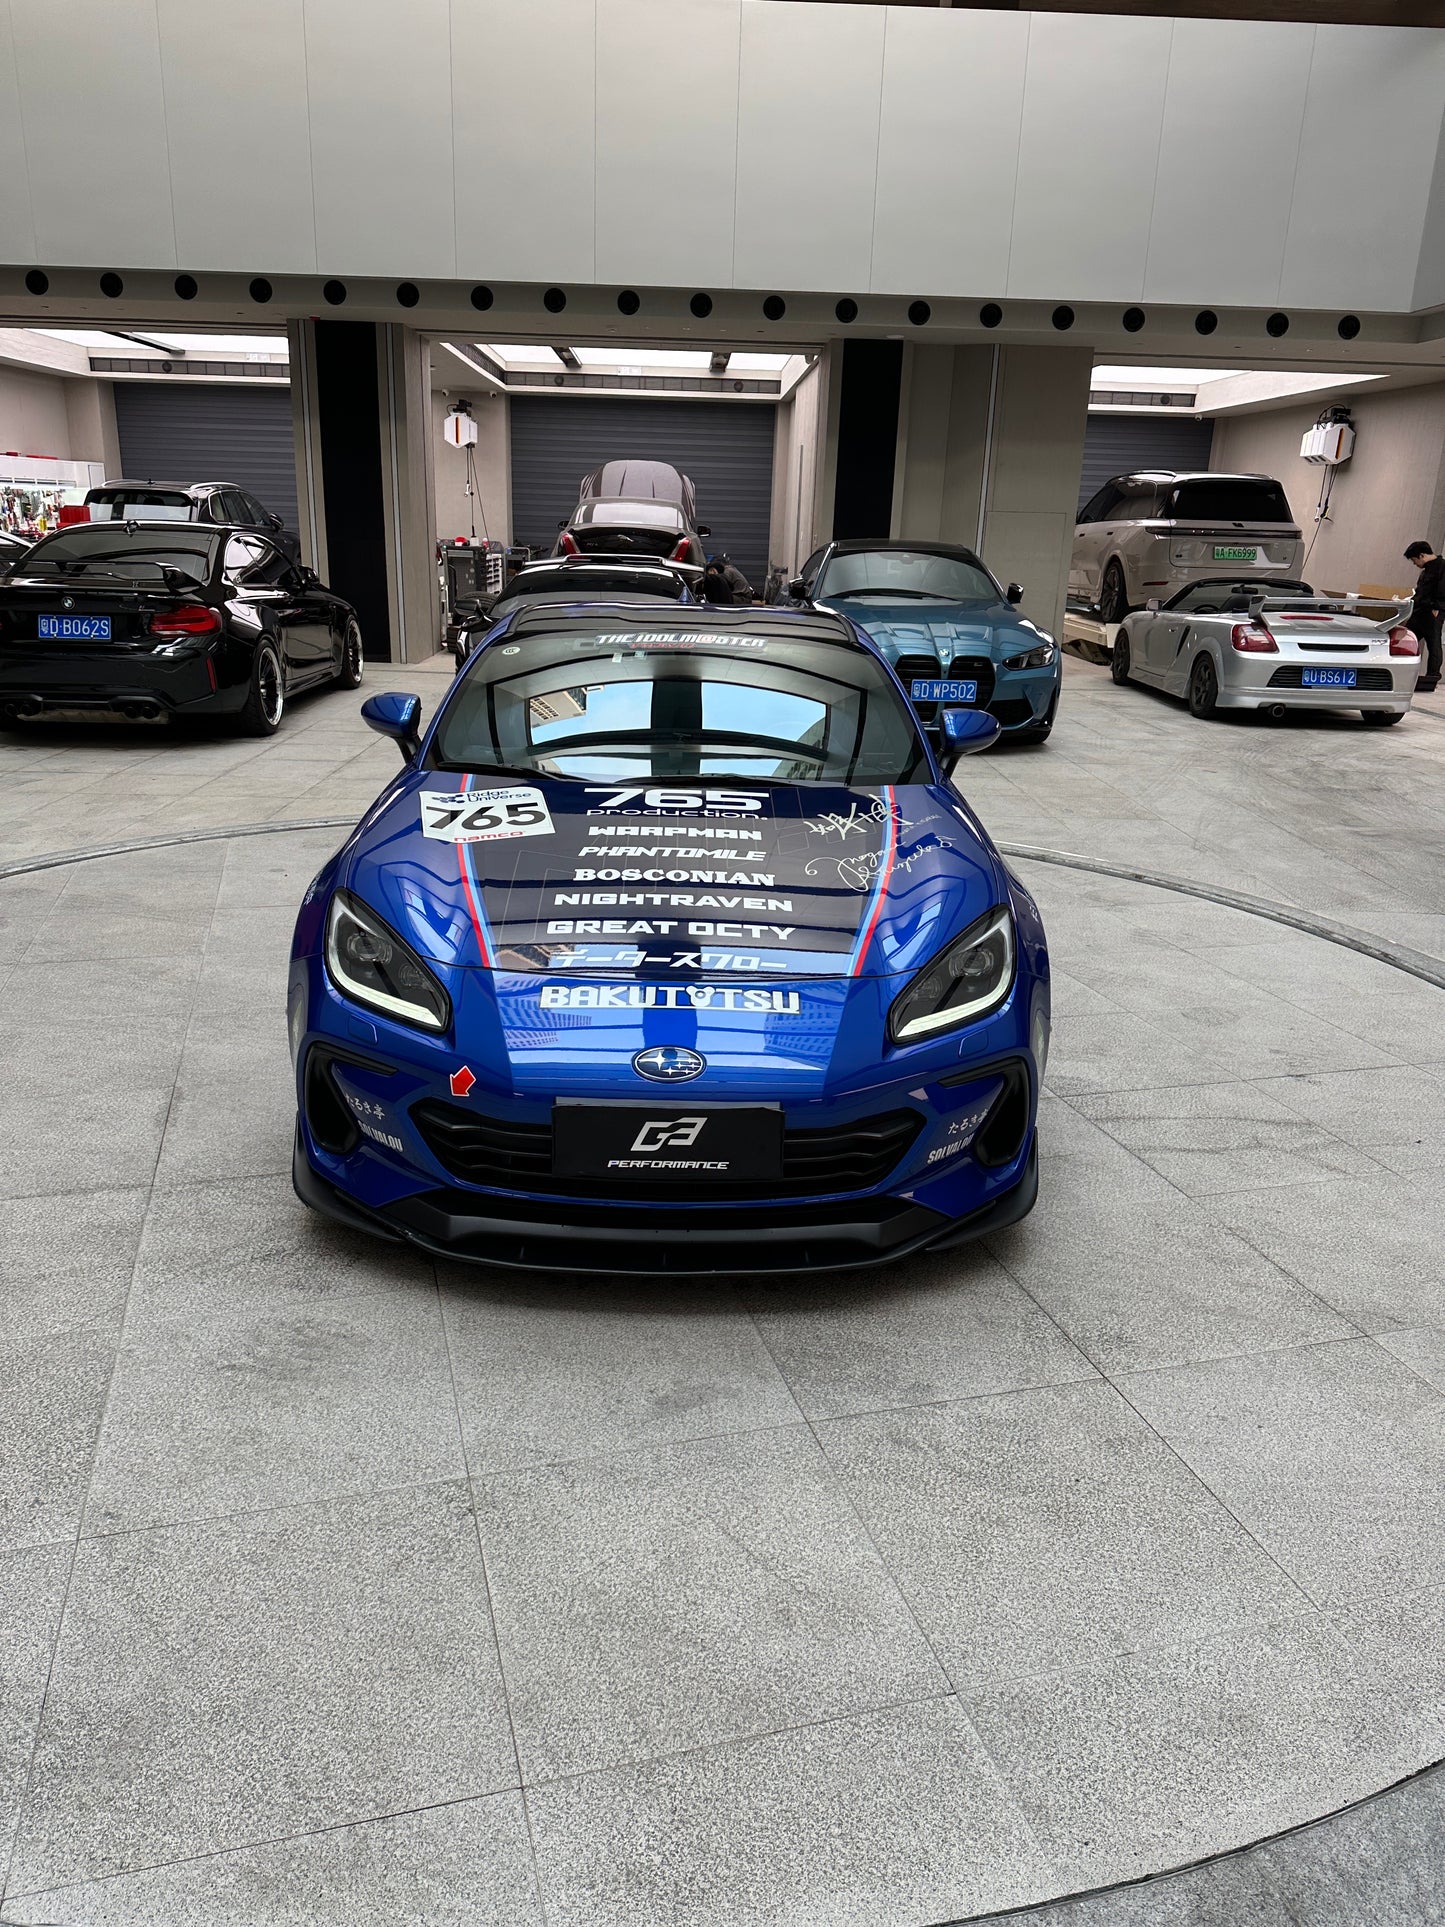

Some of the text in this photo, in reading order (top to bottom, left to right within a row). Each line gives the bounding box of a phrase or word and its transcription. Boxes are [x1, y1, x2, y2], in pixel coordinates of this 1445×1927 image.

[467, 790, 509, 798] Ridge
[468, 792, 532, 802] Universe
[584, 788, 769, 811] 765
[426, 802, 546, 830] 765
[454, 831, 524, 842] namco
[588, 826, 762, 840] WARPMAN
[578, 846, 766, 861] PHANTOMILE
[572, 869, 775, 886] BOSCONIAN
[554, 893, 793, 911] NIGHTRAVEN
[546, 920, 796, 940] GREAT OCTY
[607, 1160, 729, 1170] PERFORMANCE
